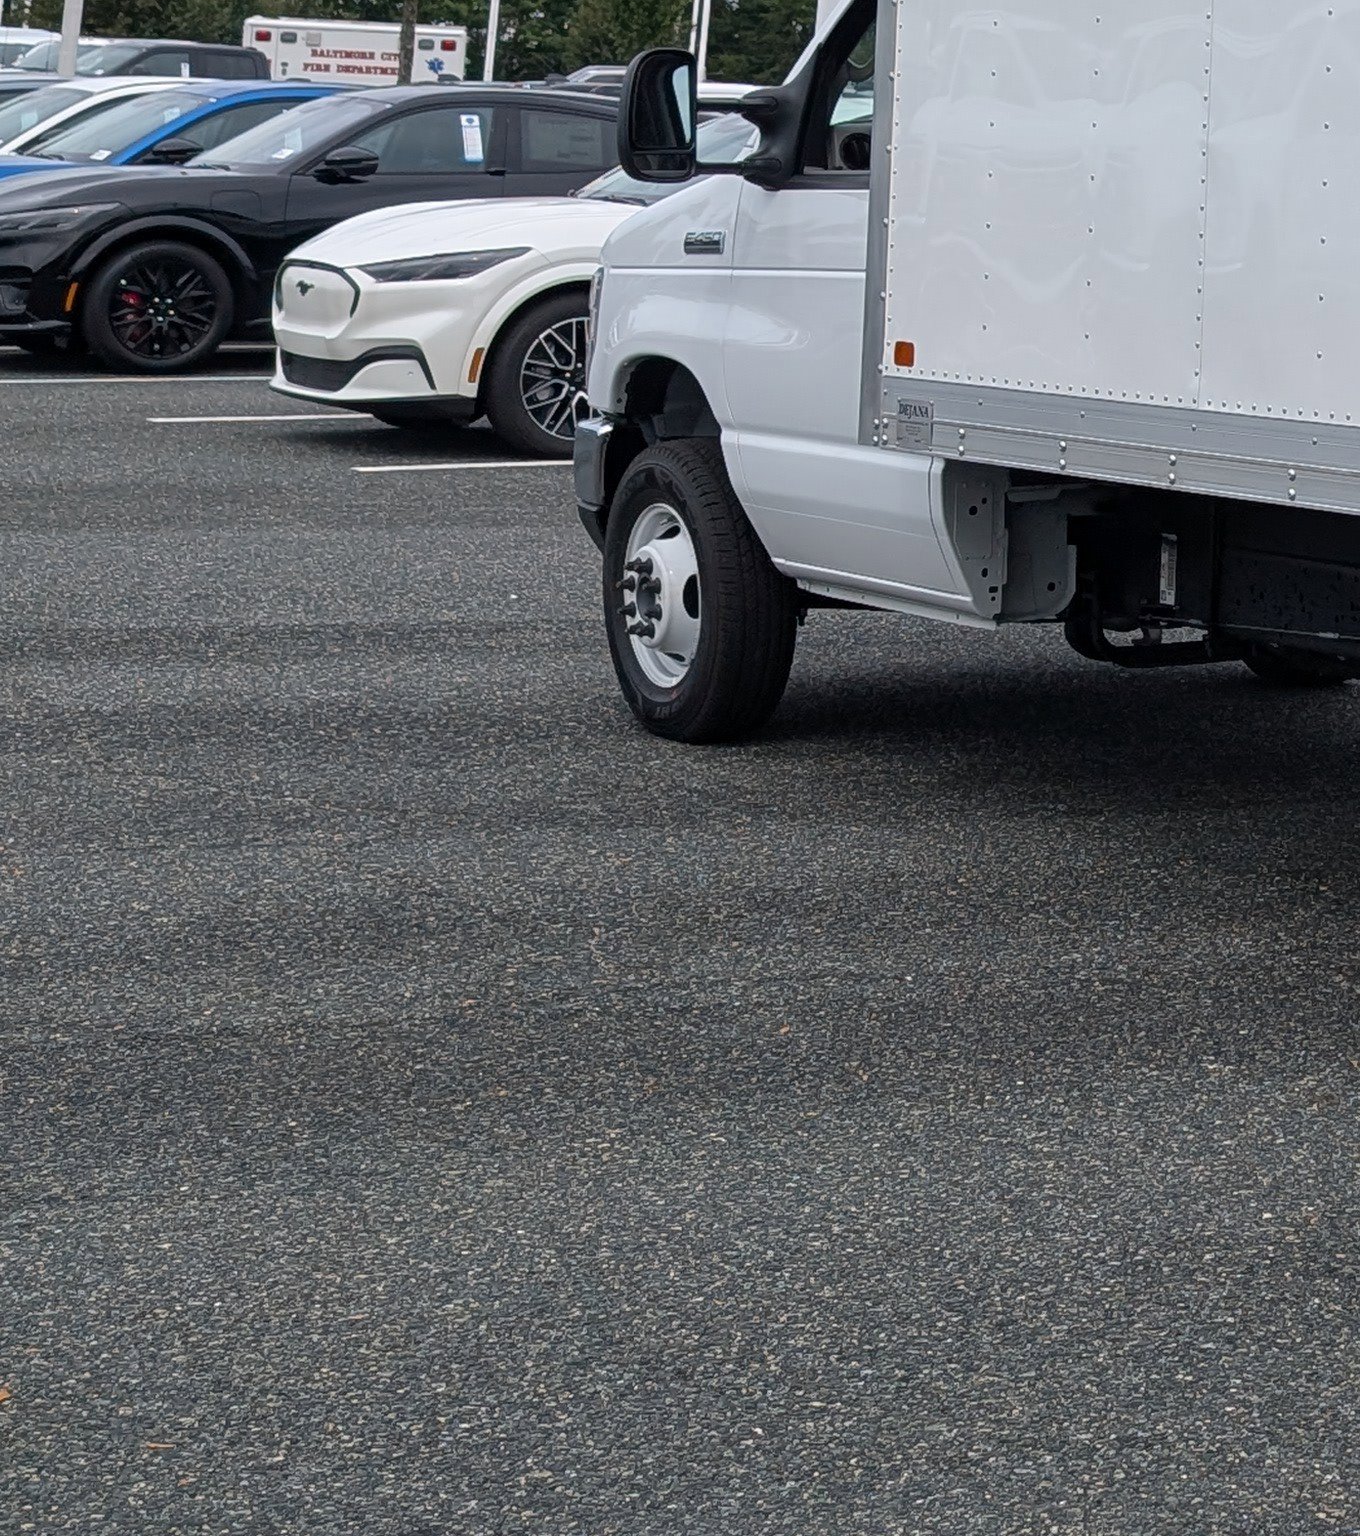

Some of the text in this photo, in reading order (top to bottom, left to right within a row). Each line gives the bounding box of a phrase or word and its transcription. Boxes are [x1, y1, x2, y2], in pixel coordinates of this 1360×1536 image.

[310, 48, 401, 62] BALTIMORE CIT
[303, 62, 400, 76] FIRE DEPARTME
